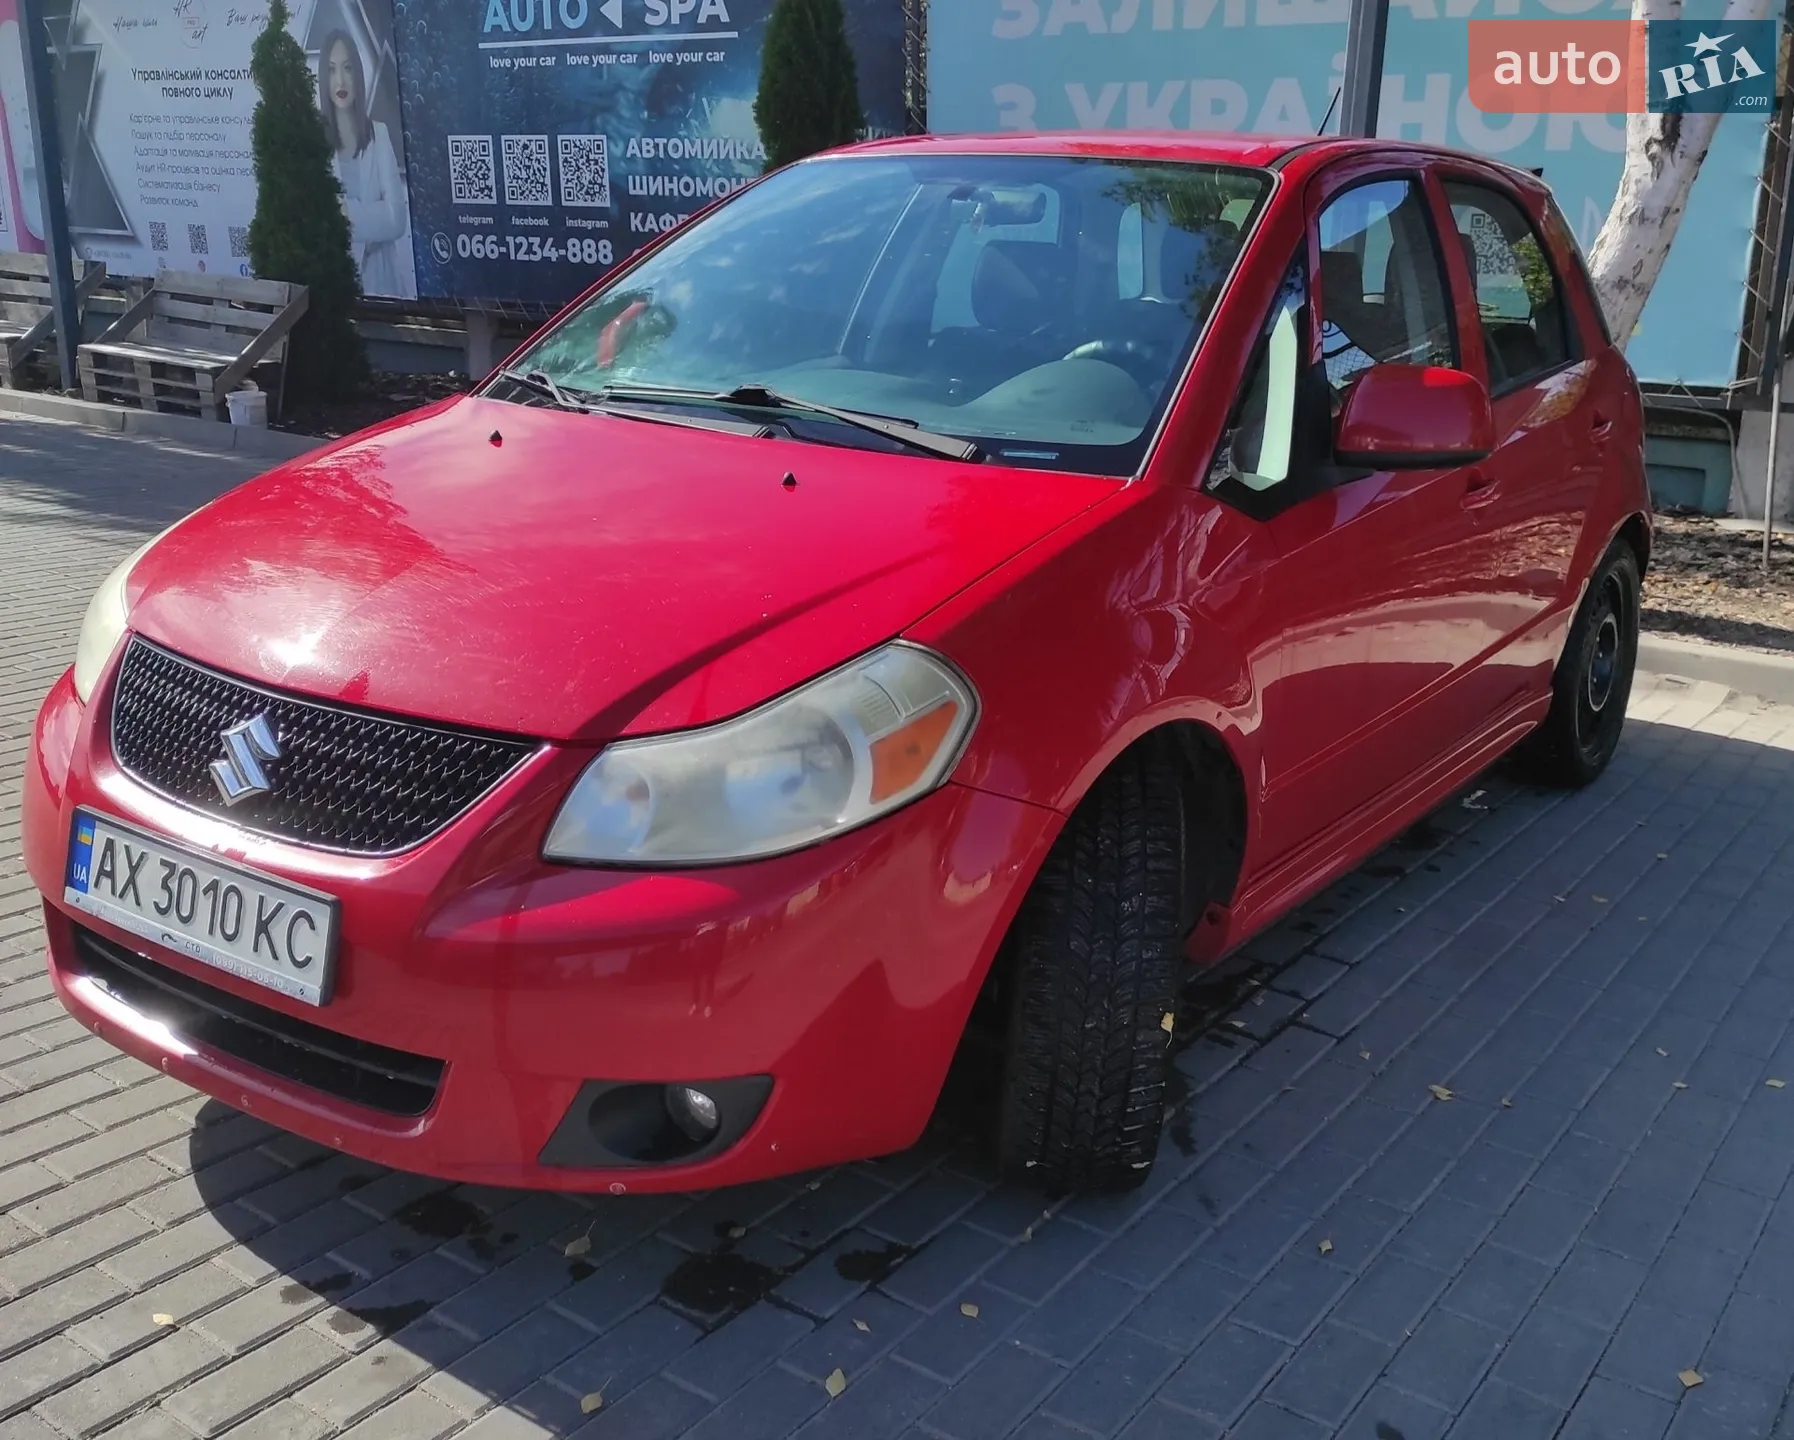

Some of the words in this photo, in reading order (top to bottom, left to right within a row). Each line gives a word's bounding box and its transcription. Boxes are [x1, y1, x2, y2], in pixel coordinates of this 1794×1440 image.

[483, 0, 589, 33] AUTO
[644, 0, 731, 26] SPA
[489, 55, 511, 68] love
[513, 57, 537, 71] your
[540, 56, 557, 67] car
[566, 53, 590, 66] love
[591, 55, 618, 69] your
[619, 54, 639, 65] car
[649, 50, 674, 63] love
[676, 52, 704, 66] your
[706, 51, 726, 62] car
[131, 67, 203, 83] Управлінський
[161, 86, 201, 98] повного
[203, 86, 234, 101] циклу
[171, 113, 219, 126] управлінське
[131, 129, 154, 141] Пошук
[186, 131, 227, 143] персоналу
[626, 134, 768, 160] АВТОМИЙКА
[193, 179, 221, 193] бізнесу
[628, 174, 757, 198] ШИНОМОН
[458, 214, 494, 226] telegram
[511, 215, 549, 227] facebook
[565, 216, 609, 229] instagram
[456, 233, 614, 265] 066-1234-888
[73, 863, 87, 884] UA
[94, 836, 148, 907] AX
[153, 858, 243, 943] 3010
[252, 893, 317, 970] KC
